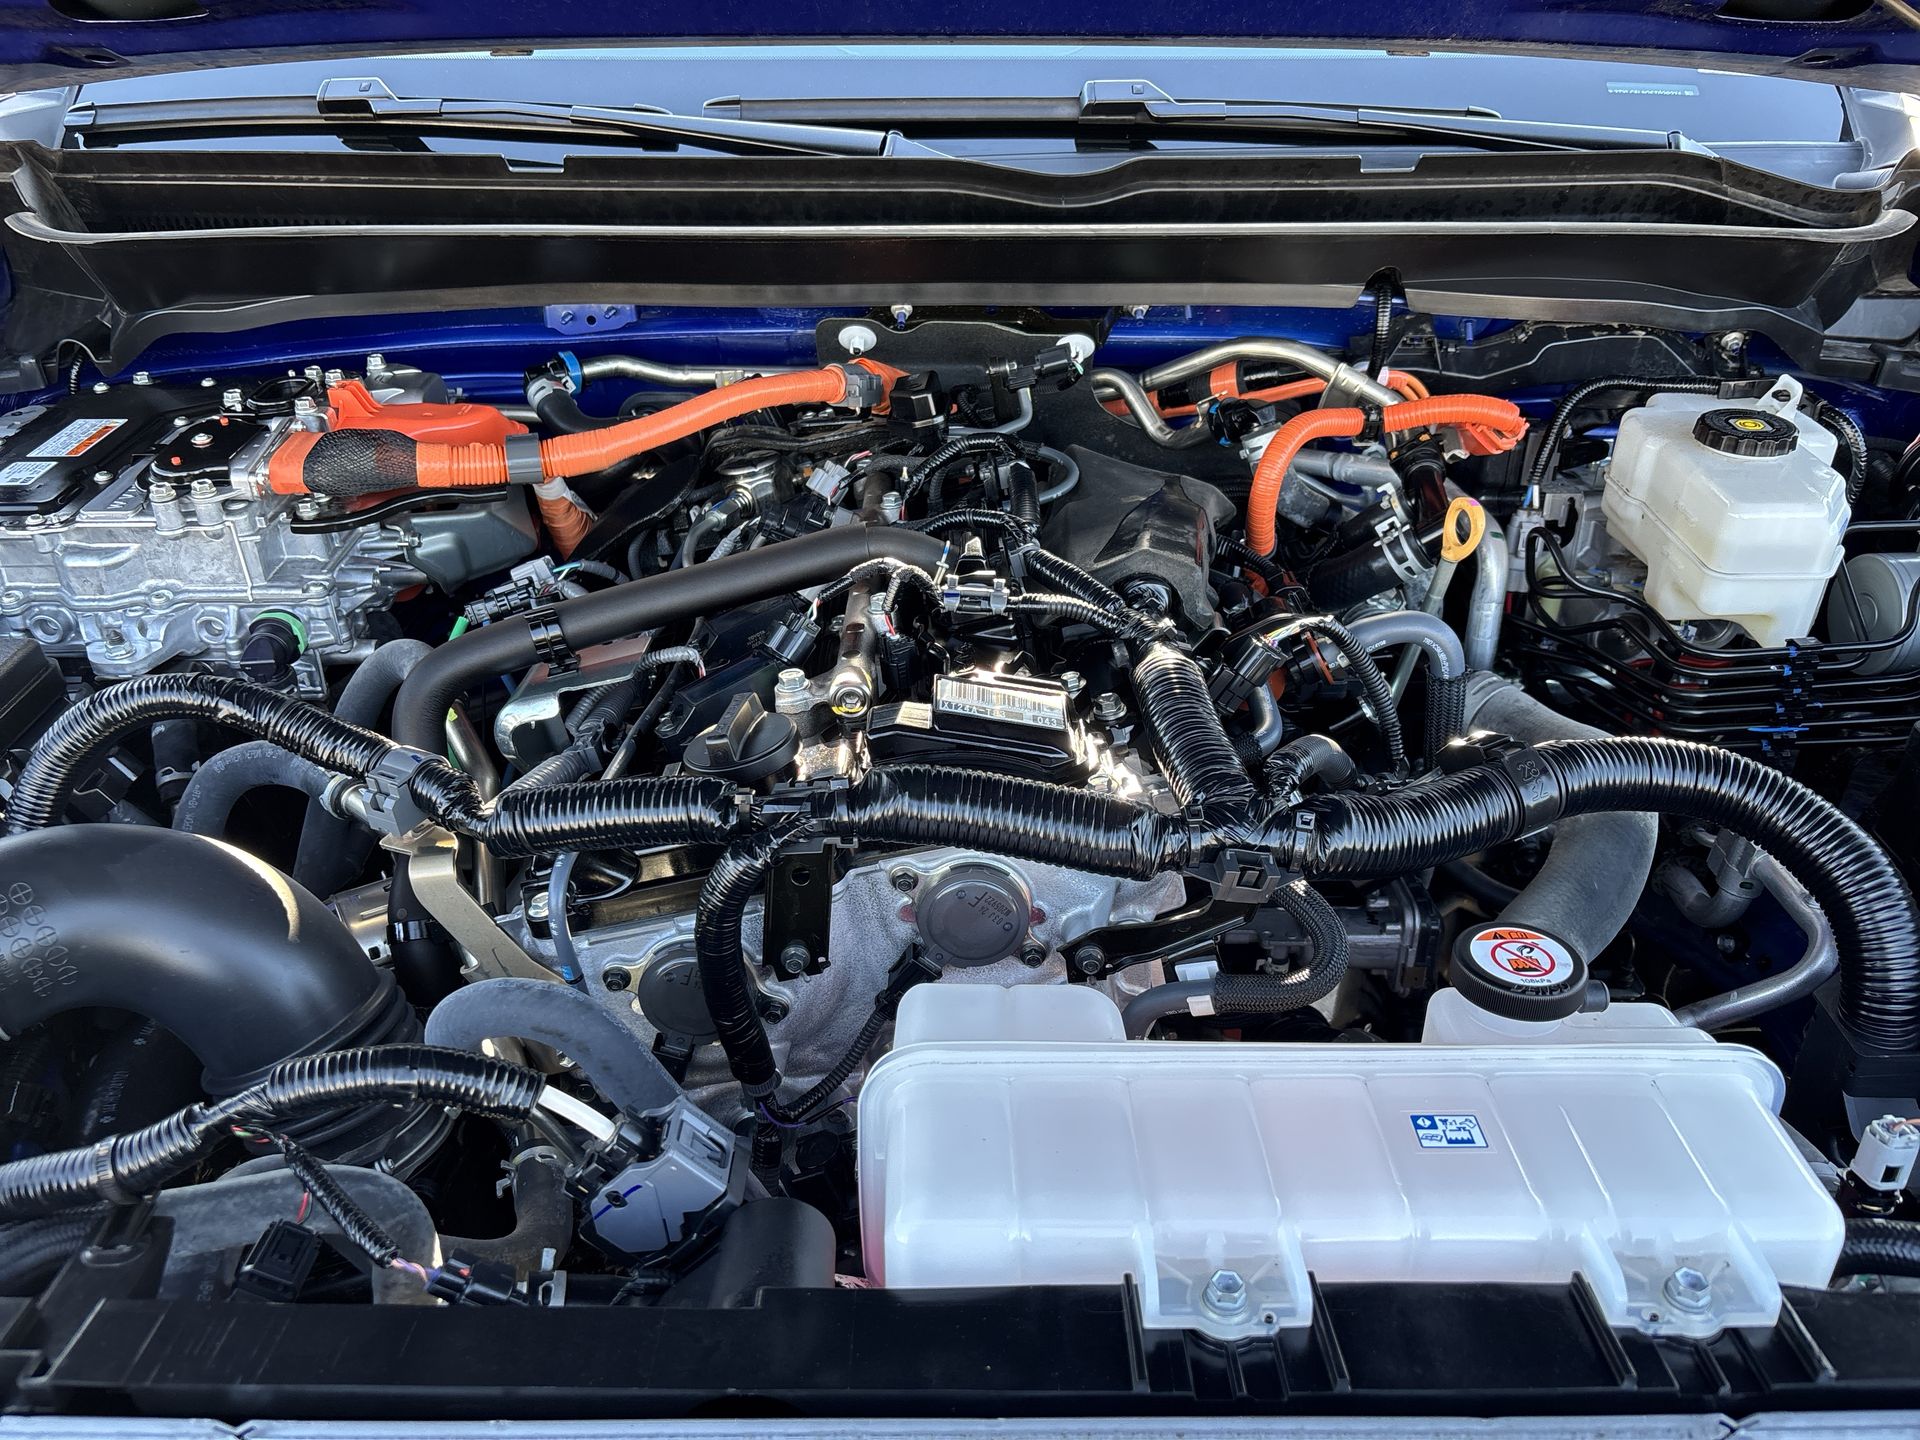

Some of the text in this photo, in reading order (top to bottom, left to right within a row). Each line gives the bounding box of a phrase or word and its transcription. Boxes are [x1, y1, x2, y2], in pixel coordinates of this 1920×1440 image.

[1037, 716, 1057, 727] 043
[1516, 759, 1541, 782] 28
[968, 891, 988, 908] F
